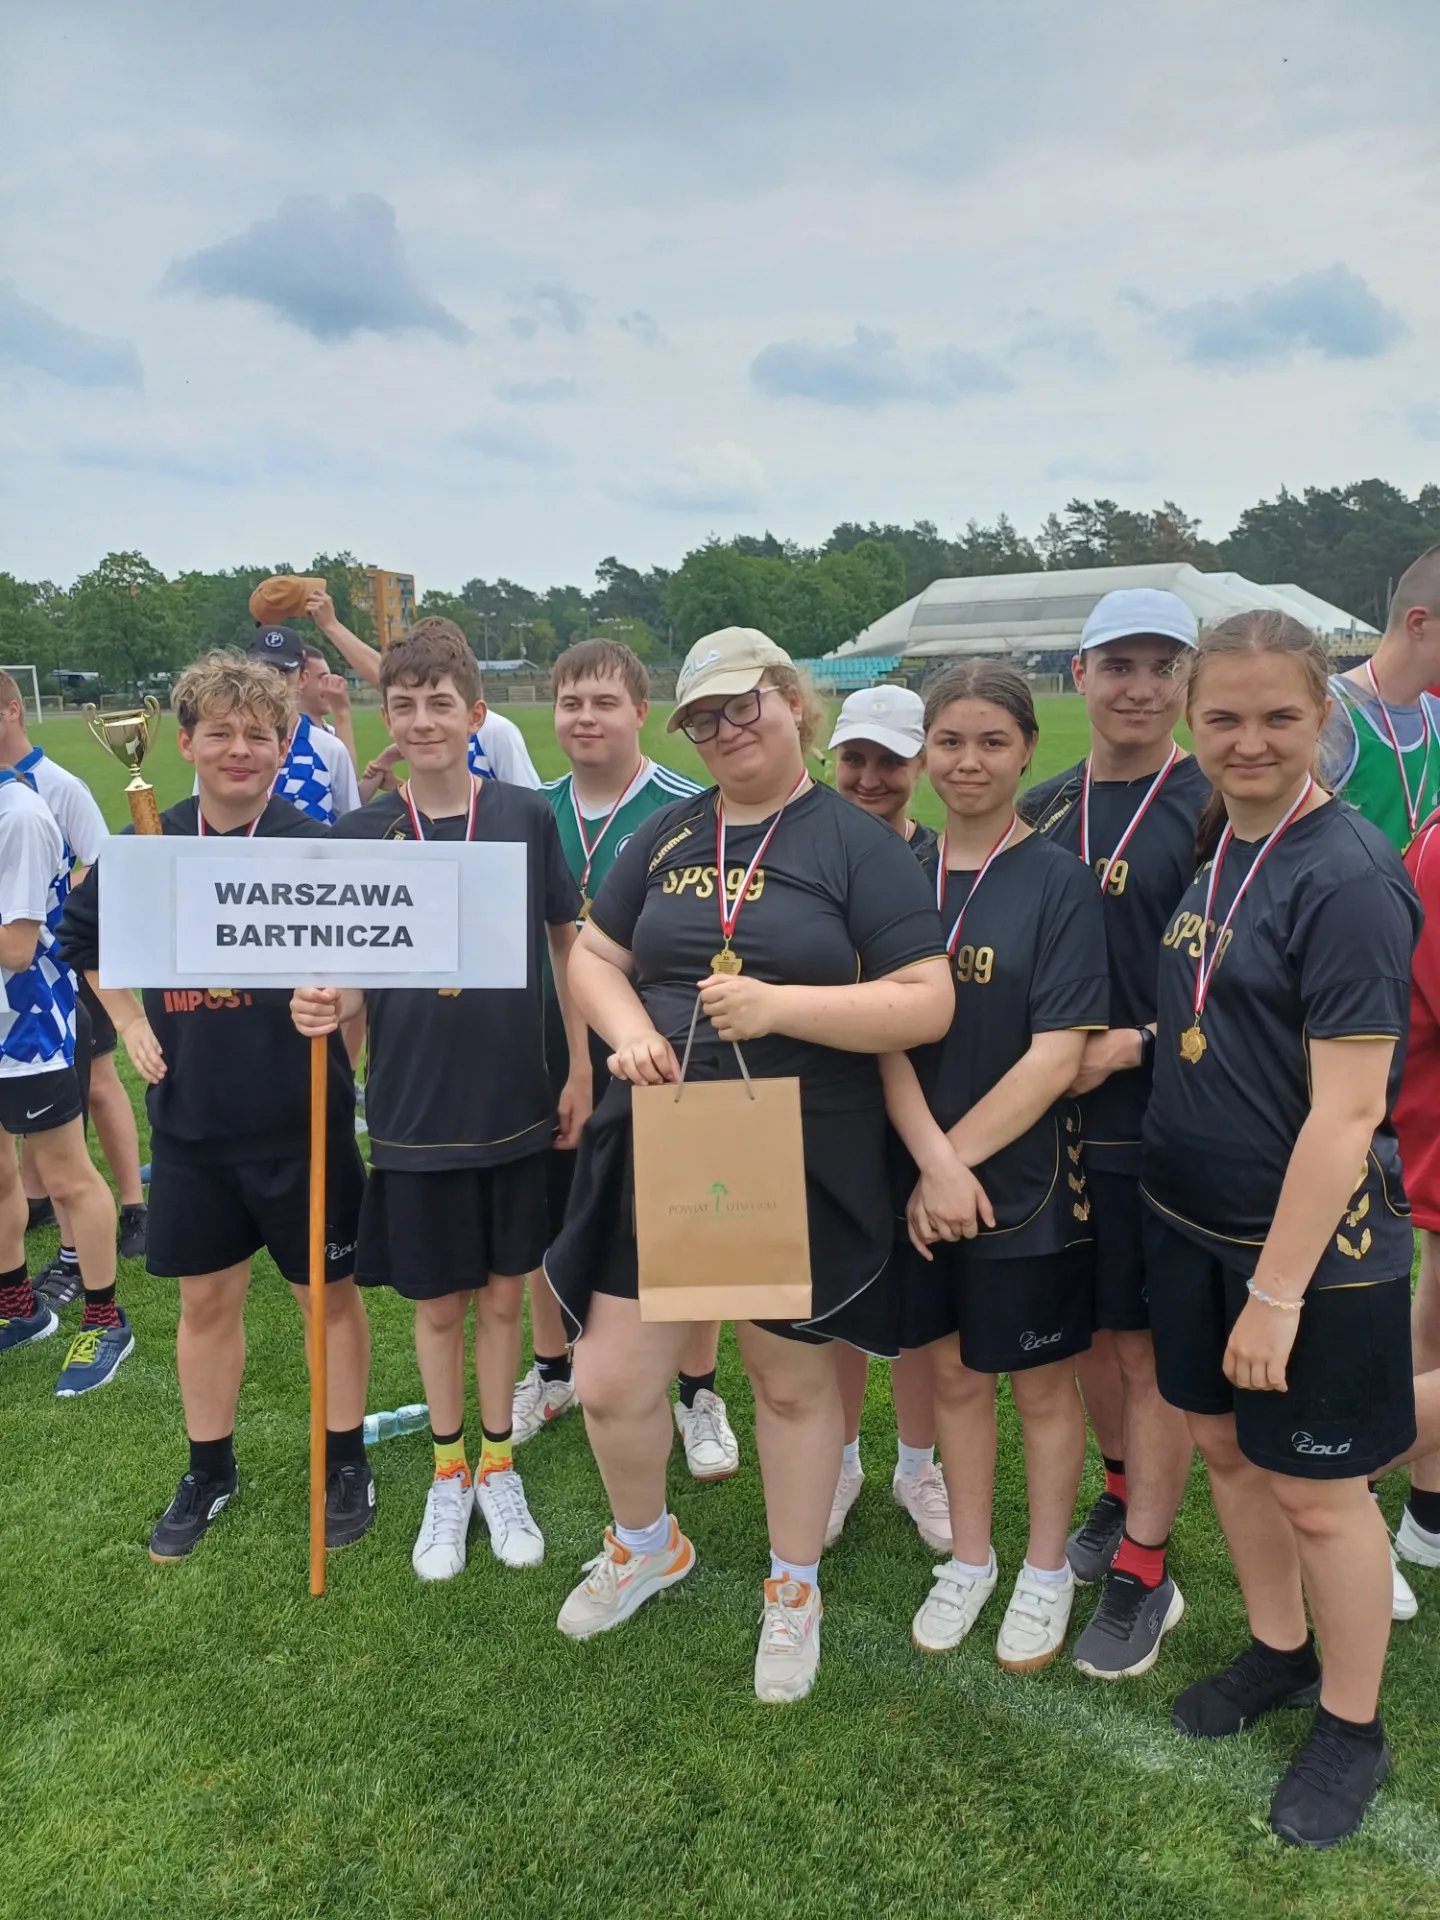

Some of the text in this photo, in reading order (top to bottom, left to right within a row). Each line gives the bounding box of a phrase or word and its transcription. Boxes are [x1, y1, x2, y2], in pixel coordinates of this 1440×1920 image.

[214, 882, 414, 906] WARSZAWA
[663, 866, 765, 901] SPS 99
[216, 924, 414, 947] BARTNICZA
[957, 945, 994, 984] 99
[669, 1203, 708, 1215] POWIAT
